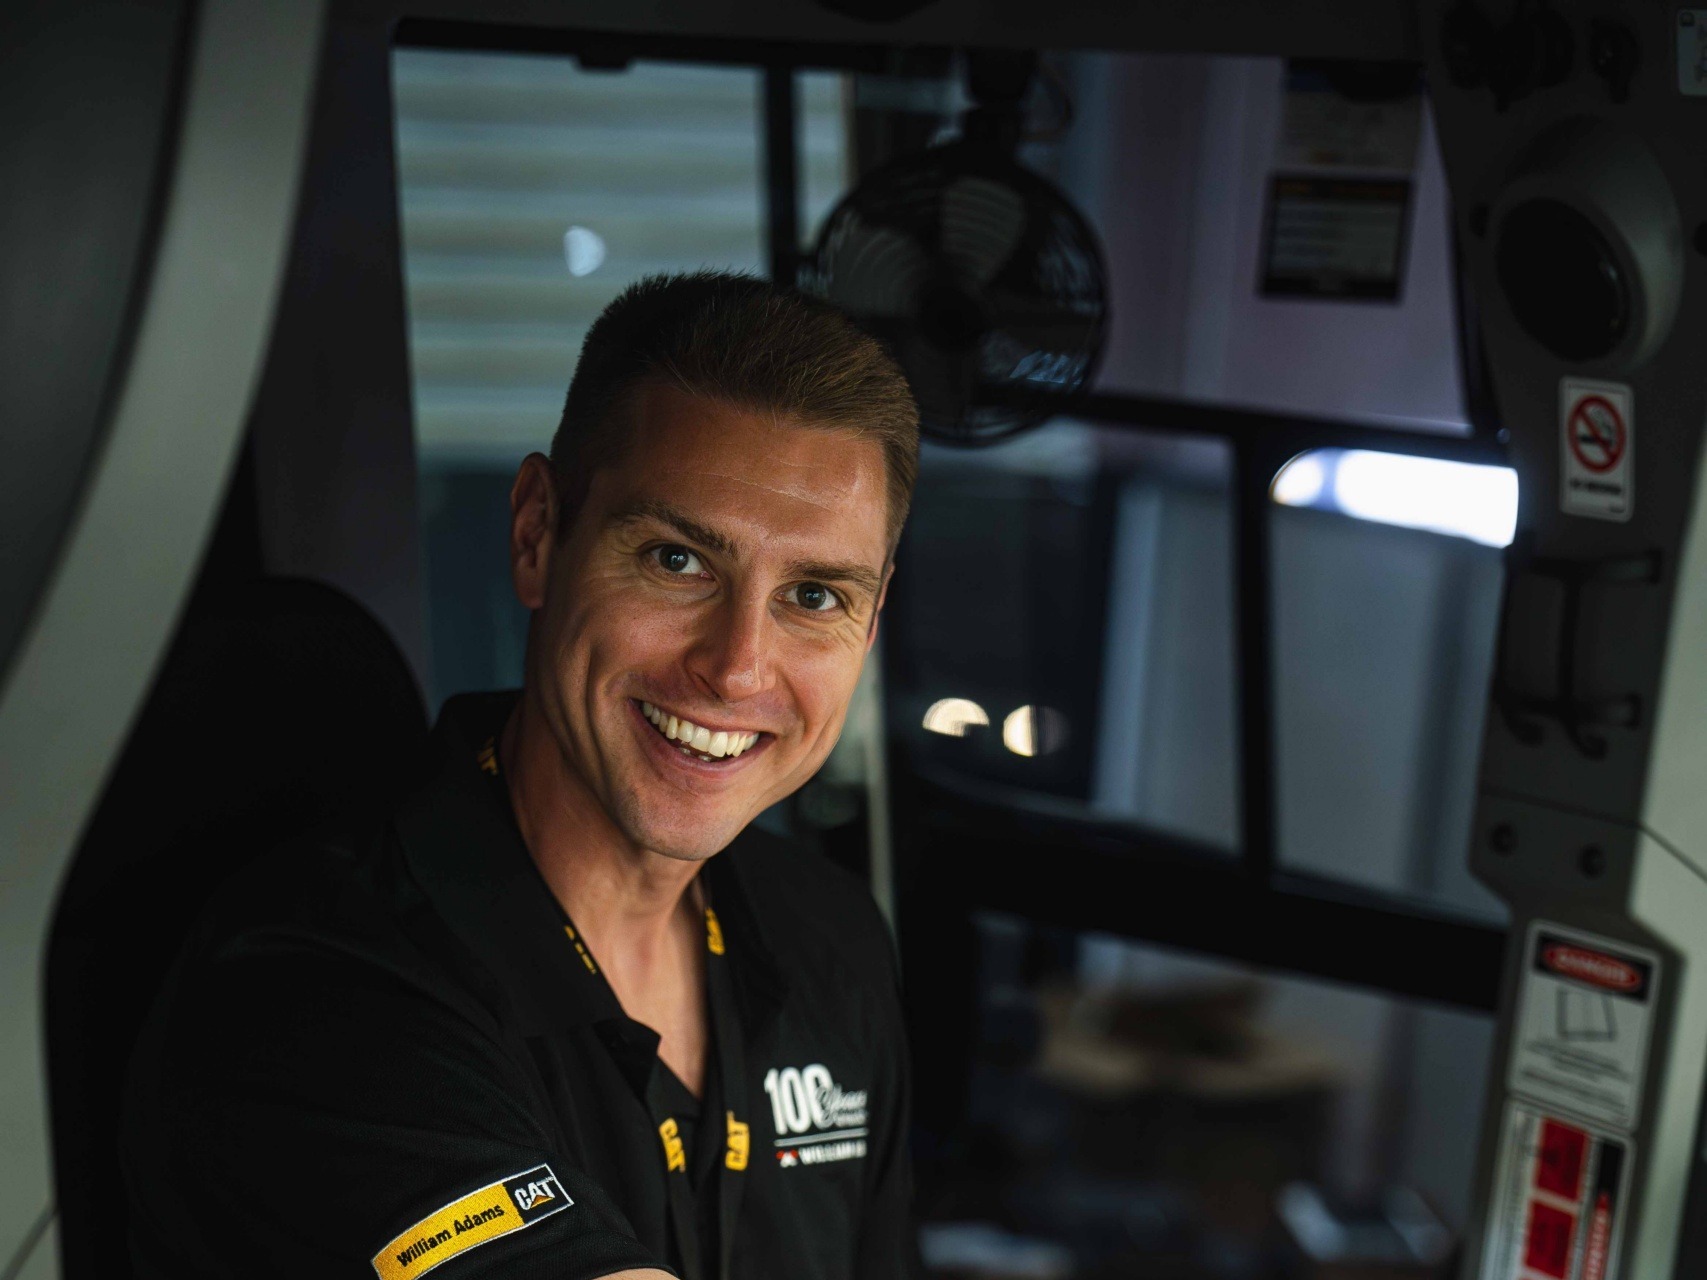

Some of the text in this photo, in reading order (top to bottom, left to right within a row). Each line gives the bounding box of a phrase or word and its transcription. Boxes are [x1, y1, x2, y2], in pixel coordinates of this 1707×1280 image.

[514, 1177, 556, 1211] CAT
[396, 1204, 505, 1268] William Adams
